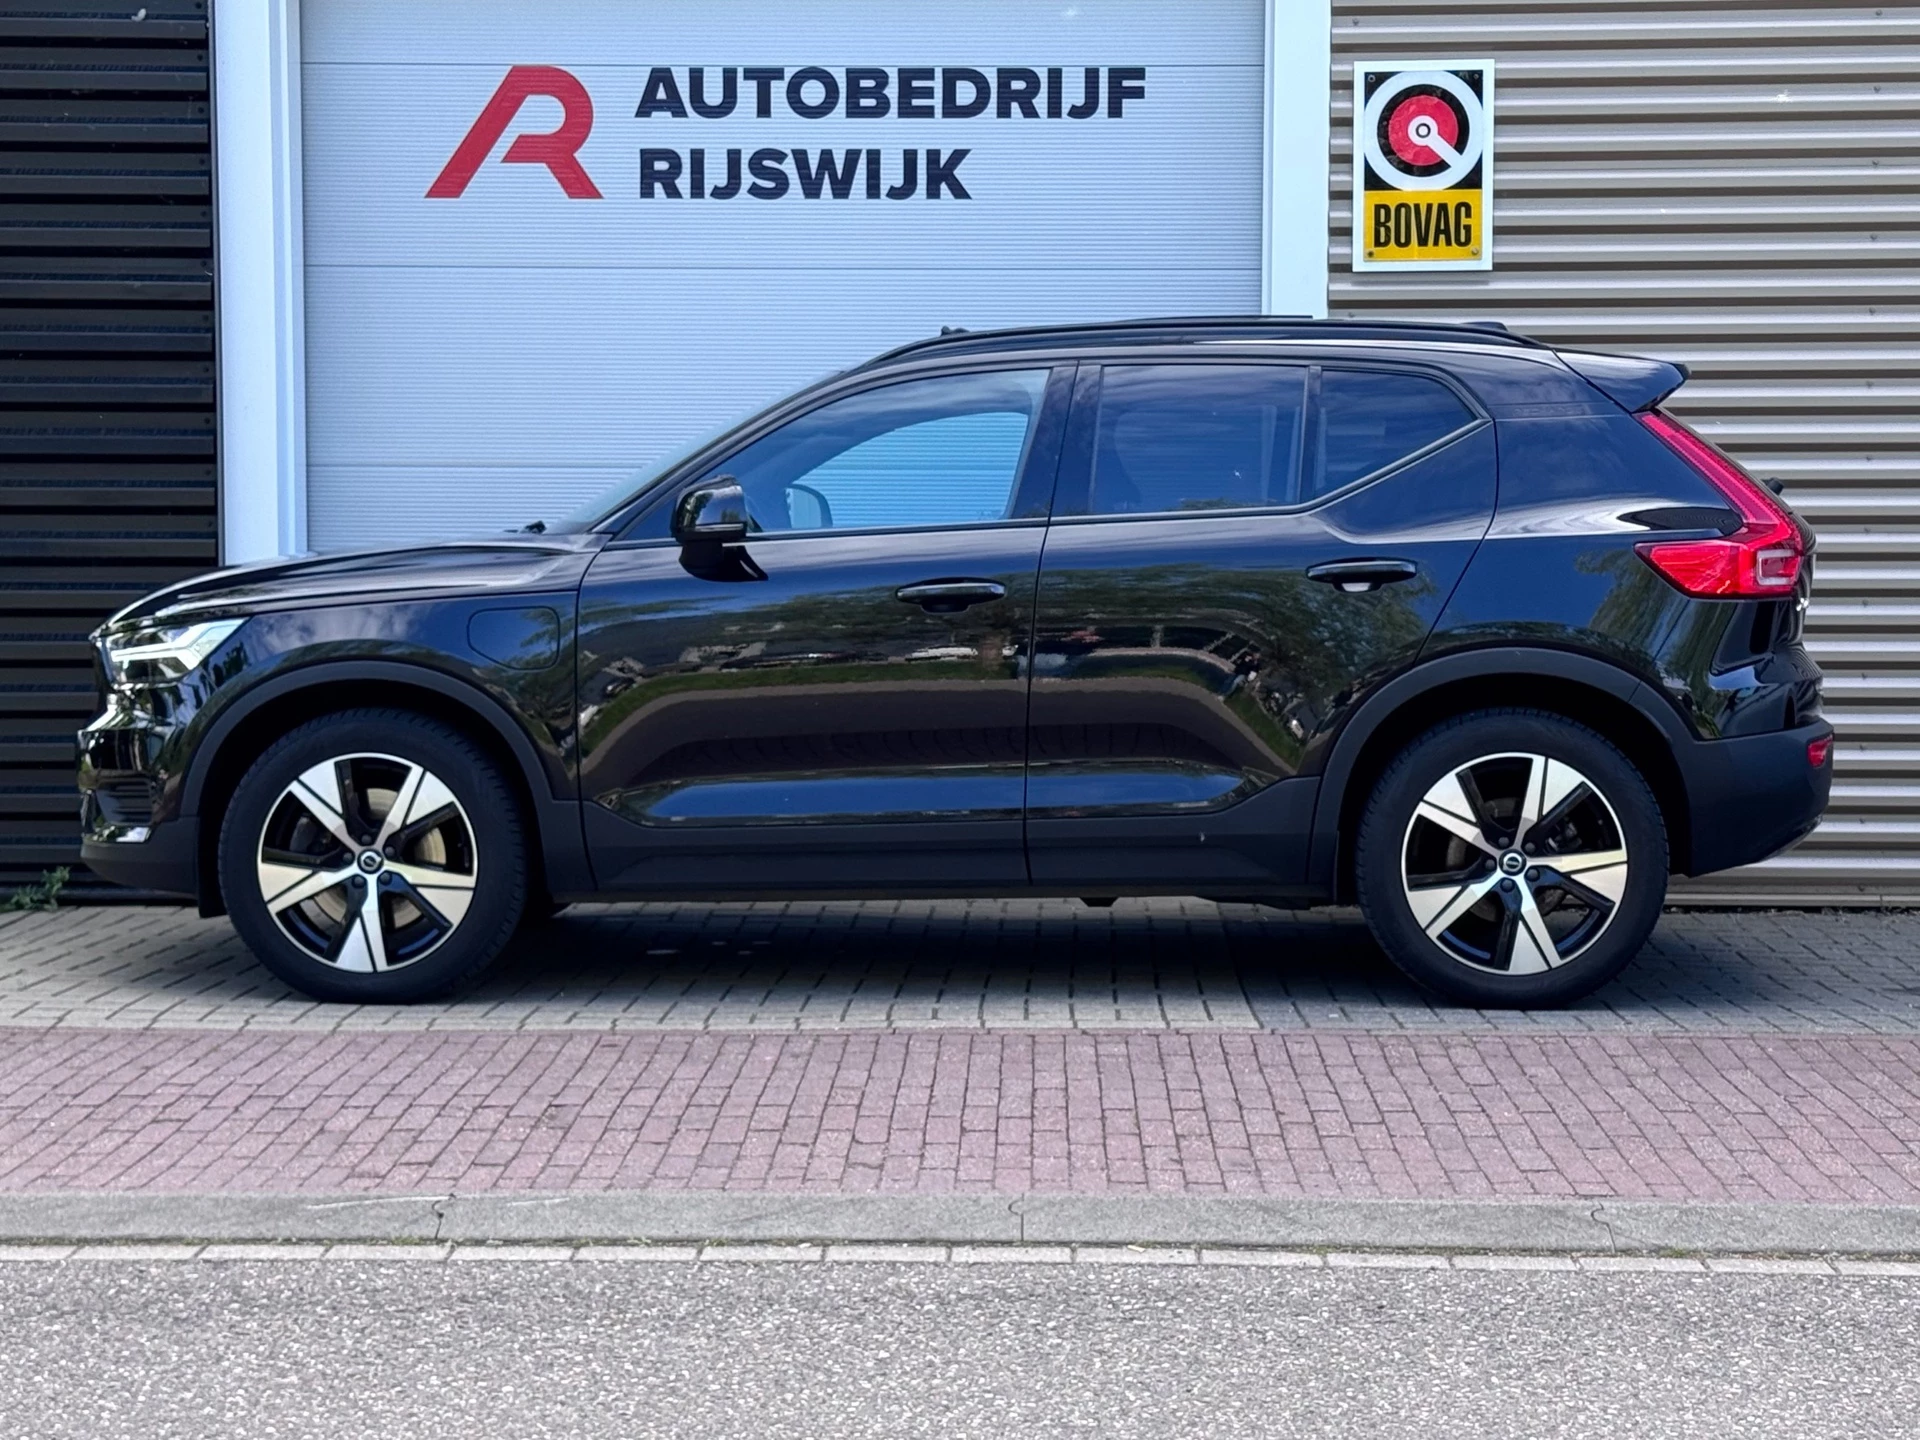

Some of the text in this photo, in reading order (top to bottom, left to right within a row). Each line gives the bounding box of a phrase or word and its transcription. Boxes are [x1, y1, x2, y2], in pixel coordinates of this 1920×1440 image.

[634, 66, 1146, 119] AUTOBEDRIJF
[639, 147, 973, 200] RIJSWIJK
[1373, 201, 1473, 248] BOVAG
